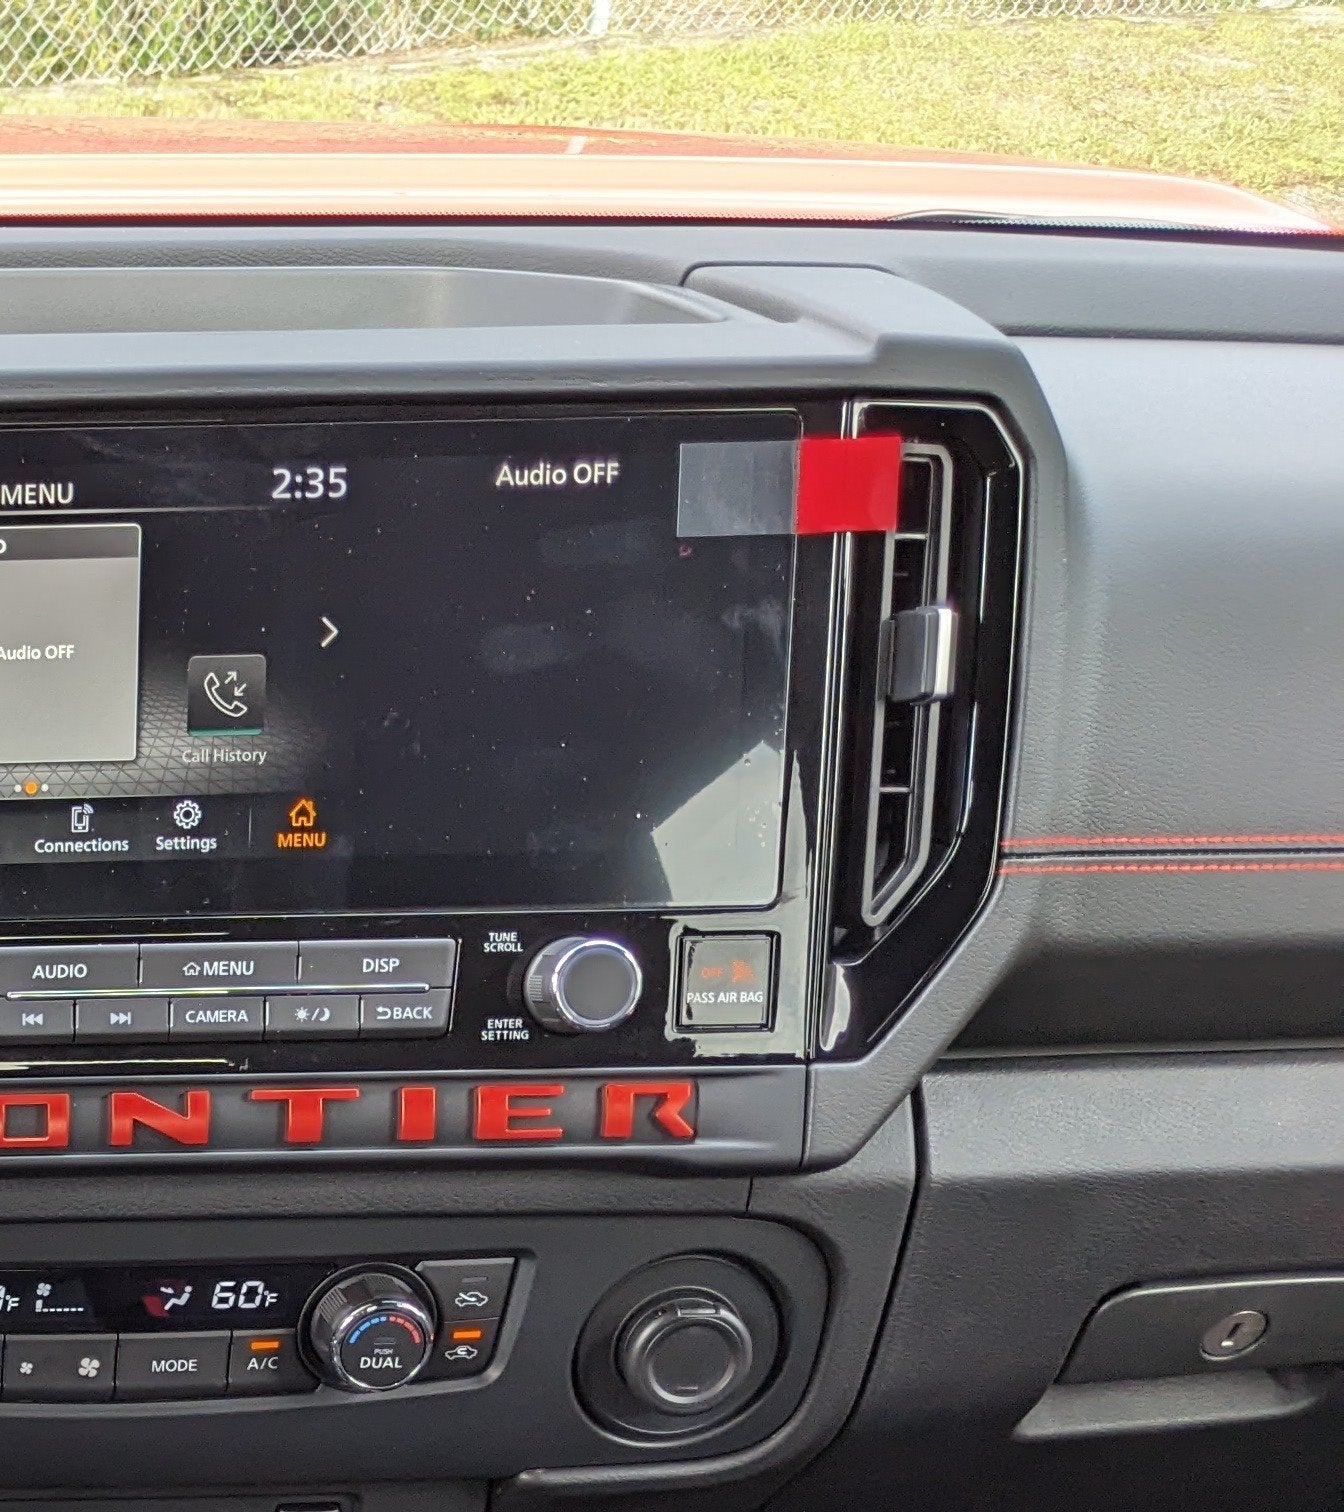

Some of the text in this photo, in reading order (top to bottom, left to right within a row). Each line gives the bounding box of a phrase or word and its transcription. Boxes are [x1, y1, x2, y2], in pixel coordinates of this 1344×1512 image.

[270, 465, 349, 500] 2:35
[496, 461, 620, 487] Audio OFF
[0, 483, 74, 505] MENU
[44, 645, 76, 660] OFF
[182, 746, 268, 767] Call History
[34, 836, 130, 855] Connections
[155, 834, 218, 853] Settings
[276, 831, 327, 850] MENU
[488, 932, 518, 942] TUNE
[483, 941, 524, 953] SCROLL
[31, 962, 89, 979] AUDIO
[203, 960, 255, 977] MENU
[362, 957, 401, 974] DISP
[686, 991, 764, 1004] PASS AIR BAG
[185, 1008, 248, 1025] CAMERA
[392, 1006, 433, 1021] BACK
[486, 1018, 524, 1030] ENTER
[480, 1028, 530, 1042] SETTING
[151, 1357, 198, 1374] MODE
[246, 1355, 279, 1373] A/C
[359, 1356, 403, 1369] DUAL
